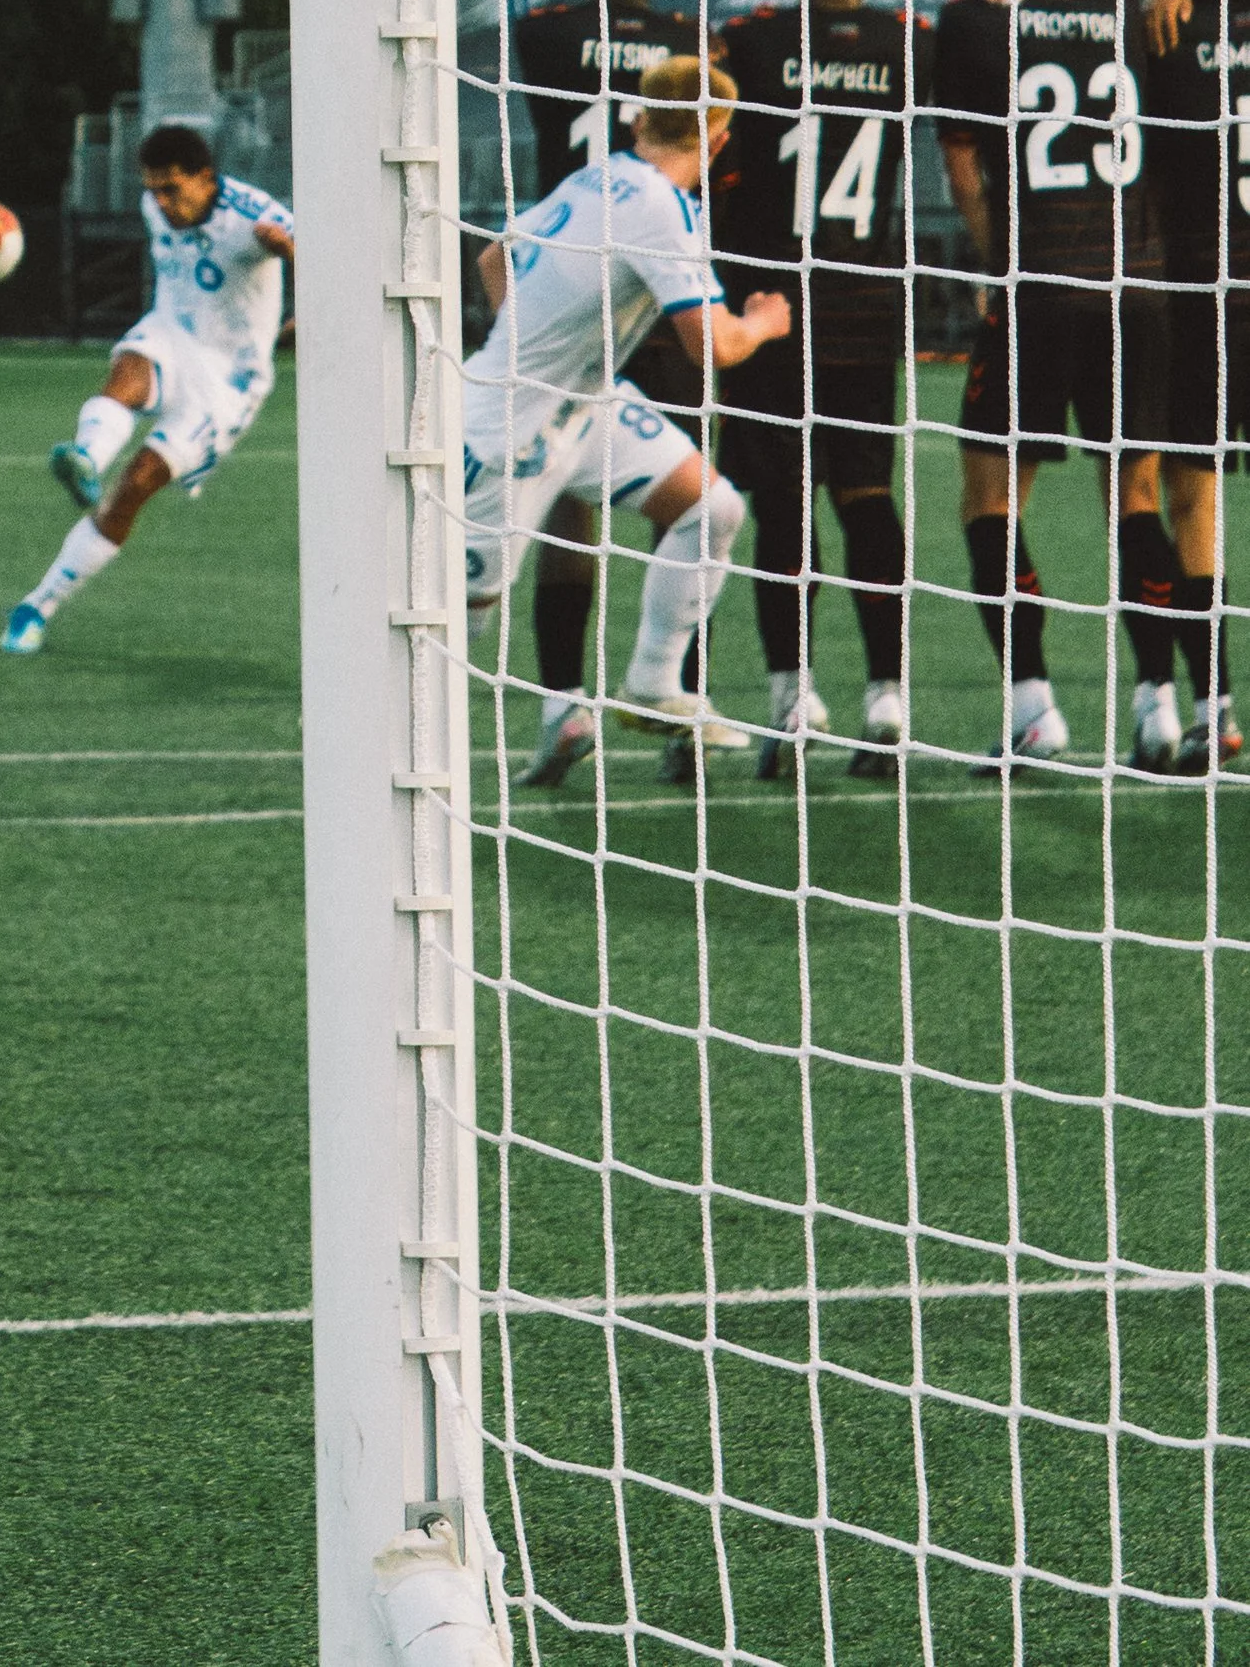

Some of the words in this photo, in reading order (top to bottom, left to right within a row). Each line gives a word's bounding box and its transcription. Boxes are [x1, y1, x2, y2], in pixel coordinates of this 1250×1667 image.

[783, 57, 891, 94] CAMPBELL
[569, 100, 644, 167] 1
[1017, 62, 1142, 192] 23
[778, 112, 884, 240] 14
[619, 401, 663, 440] 8
